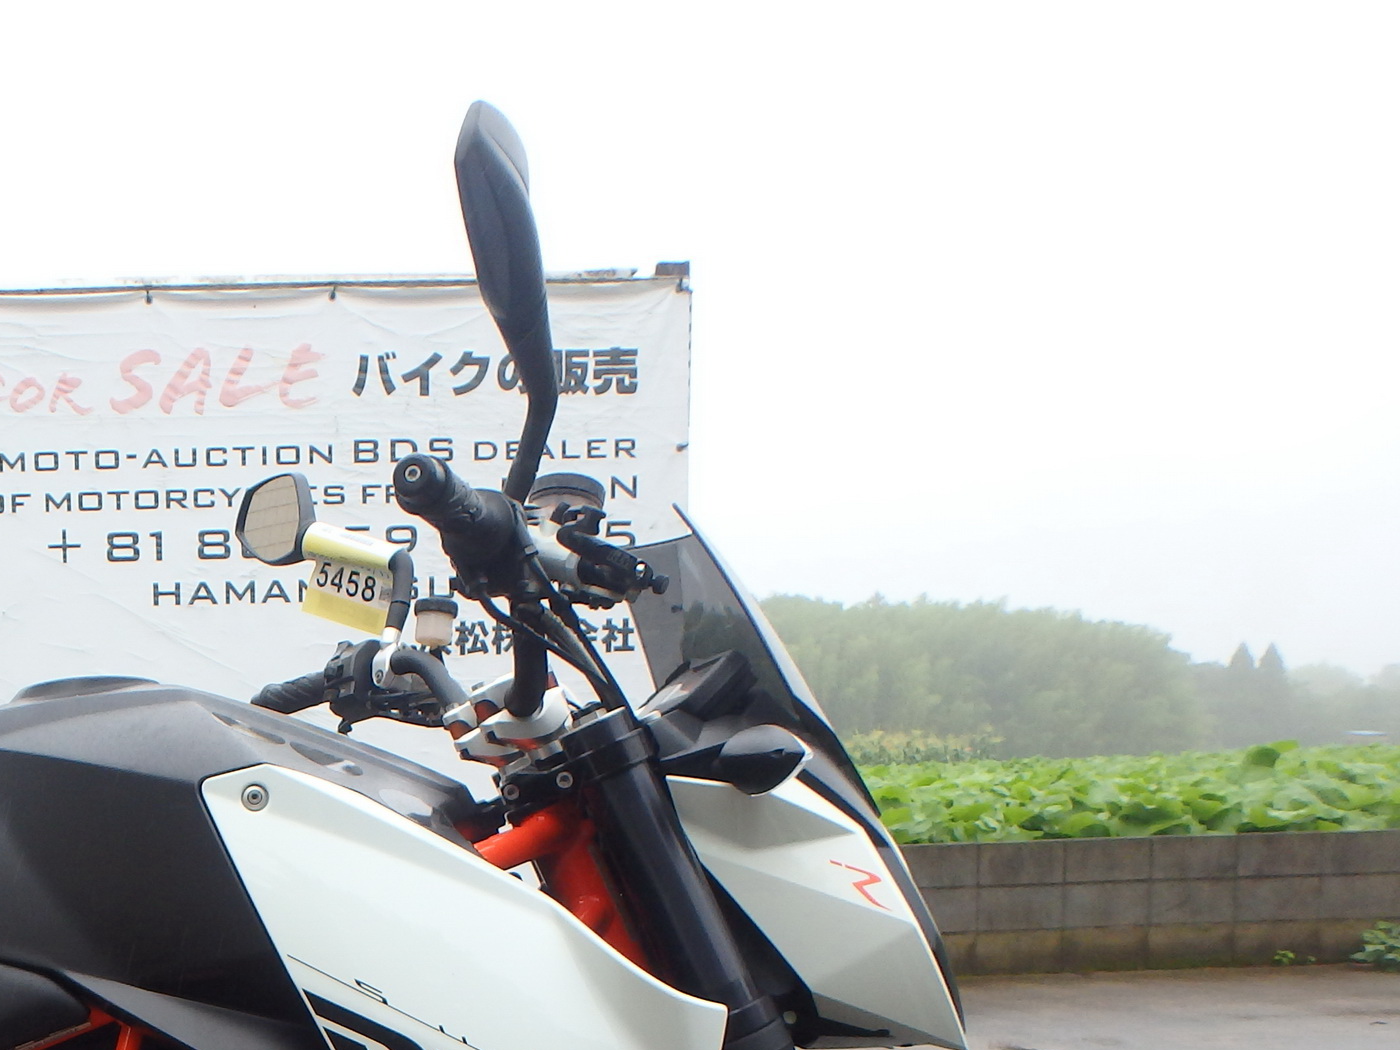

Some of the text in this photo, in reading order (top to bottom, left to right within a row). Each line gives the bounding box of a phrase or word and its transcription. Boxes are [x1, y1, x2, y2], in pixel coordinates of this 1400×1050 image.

[108, 343, 331, 416] SALE
[353, 437, 455, 464] BDS
[106, 530, 164, 562] 81
[316, 561, 377, 602] 5458
